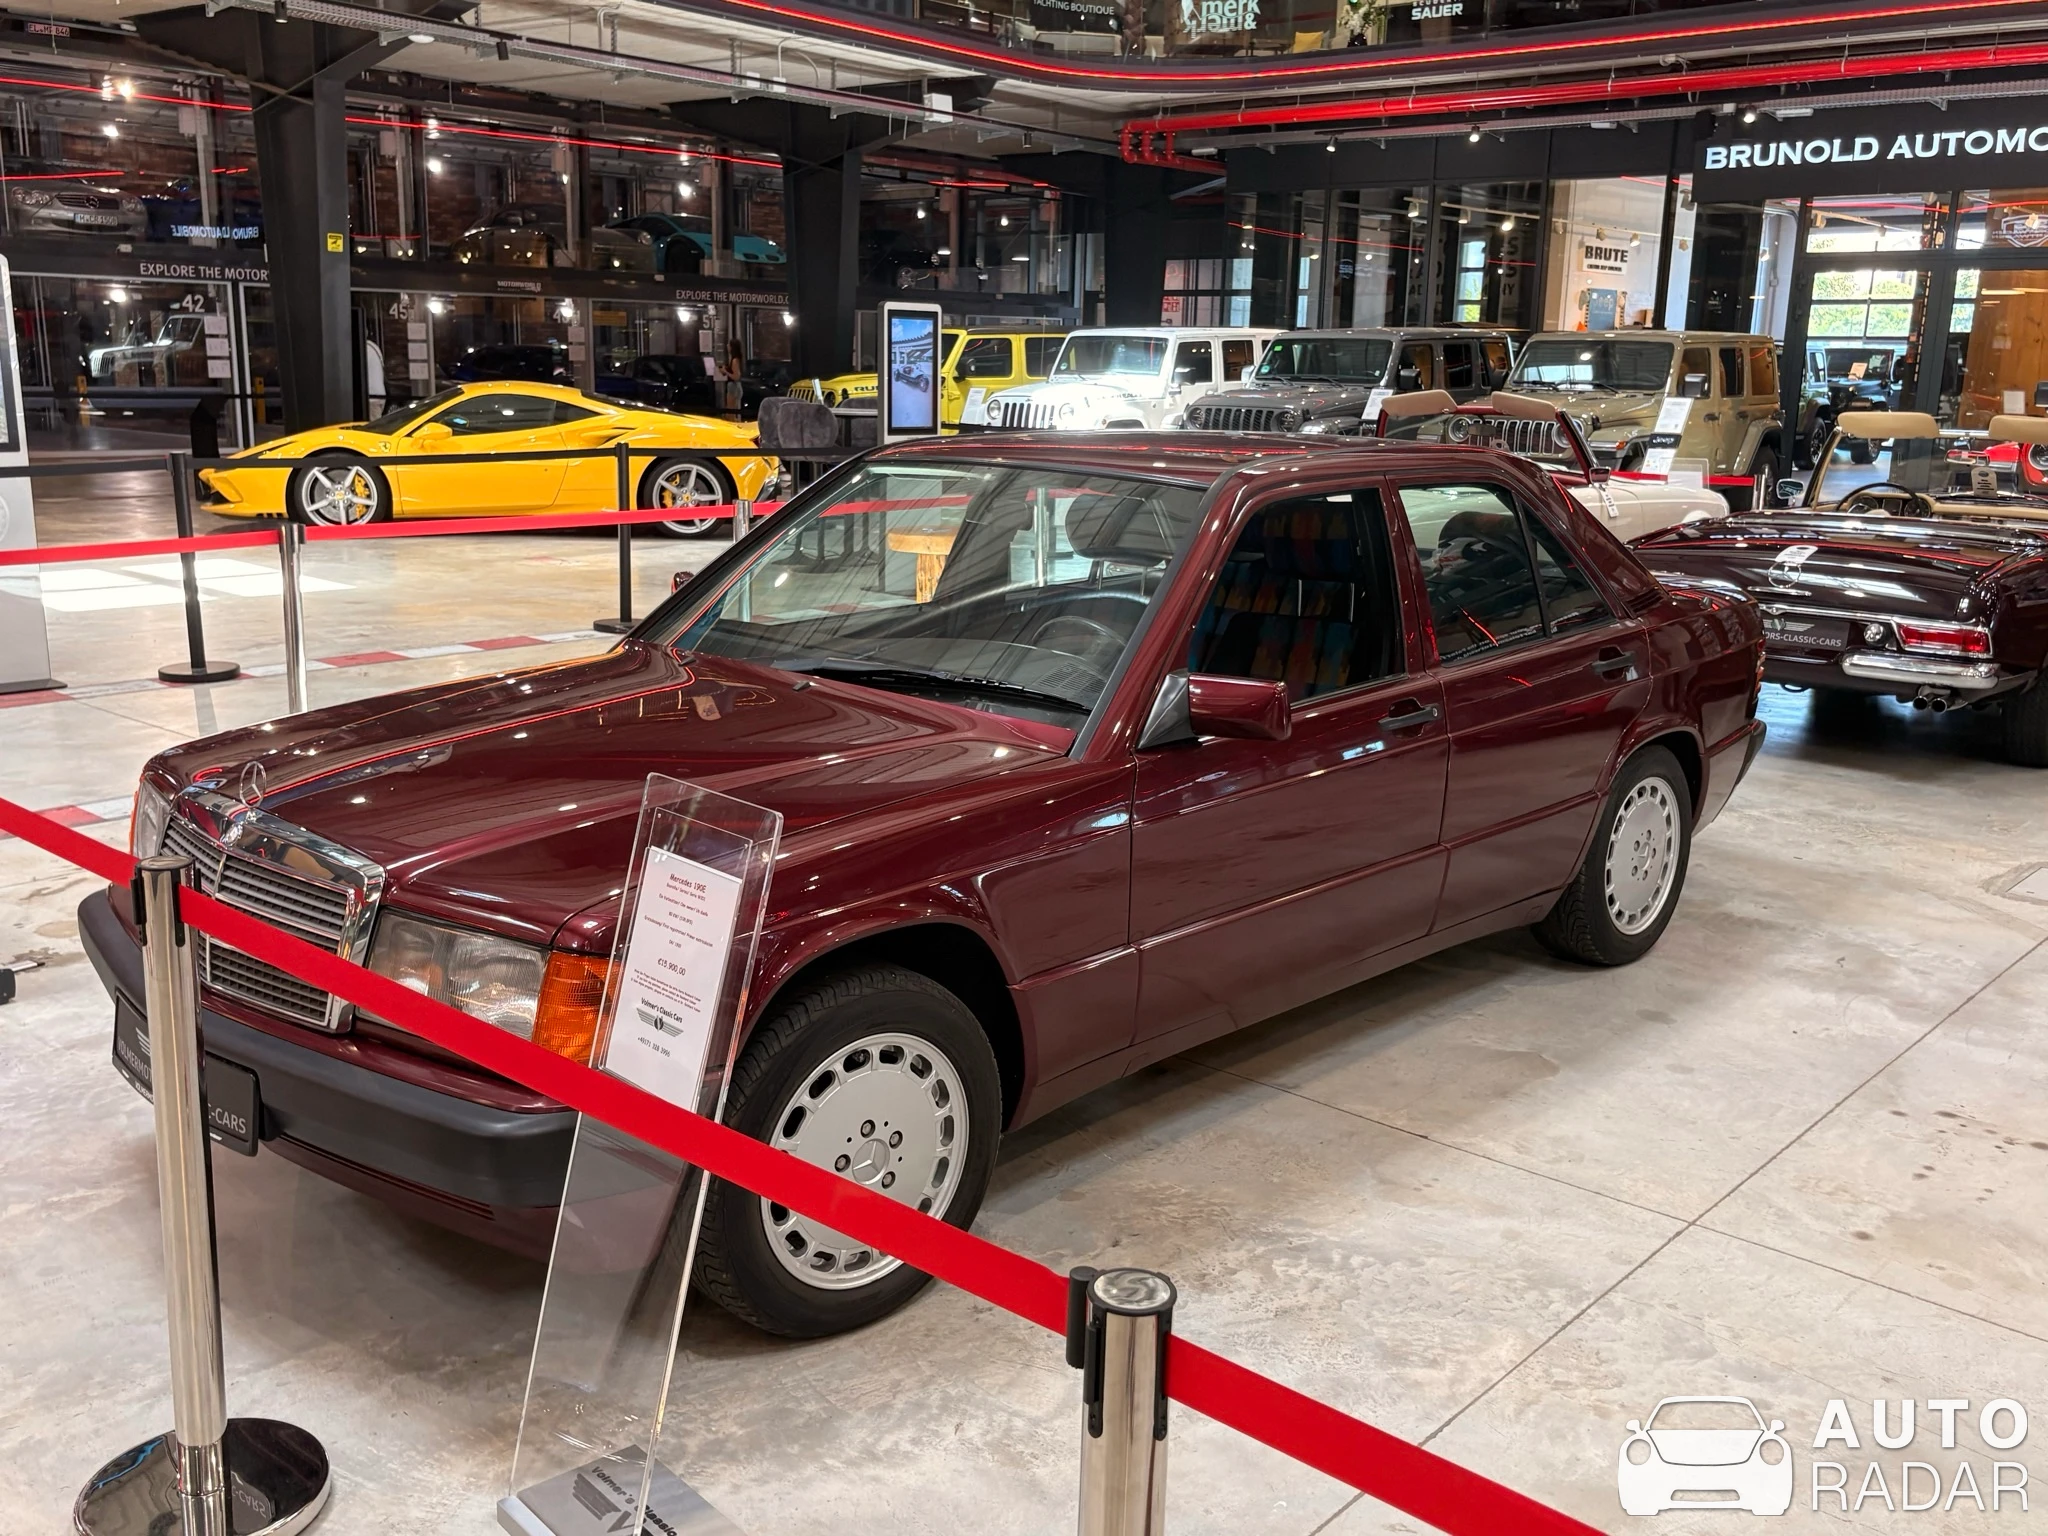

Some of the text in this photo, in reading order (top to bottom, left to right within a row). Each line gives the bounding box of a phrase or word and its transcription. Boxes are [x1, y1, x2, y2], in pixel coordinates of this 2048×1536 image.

[1070, 3, 1115, 15] BOUTIQUE
[1411, 3, 1463, 20] SAUER
[1705, 126, 2048, 170] BRUNOLD AUTOMO
[1585, 245, 1628, 263] BRUTE
[140, 262, 269, 281] EXPLORE THE MOTOR
[182, 294, 205, 312] 42
[676, 289, 711, 301] EXPLORE
[713, 291, 728, 302] THE
[389, 303, 408, 319] 45
[670, 873, 692, 888] Mercedes
[657, 958, 686, 976] €15.900,00
[641, 997, 683, 1023] Volmer's Classic Cars
[591, 1466, 636, 1505] Volmer's
